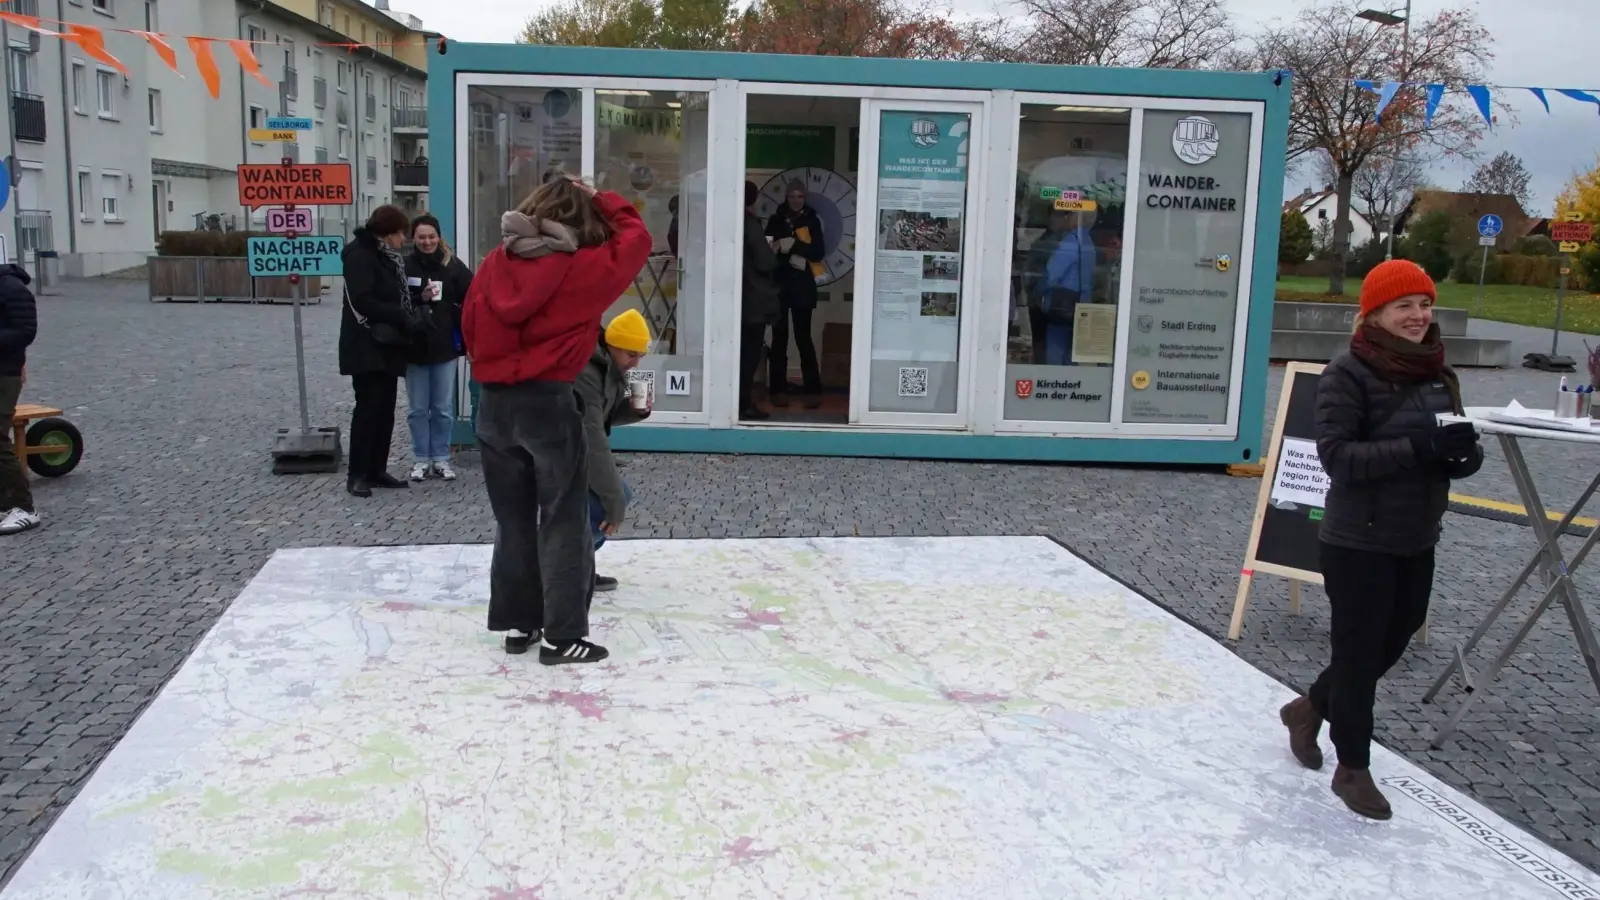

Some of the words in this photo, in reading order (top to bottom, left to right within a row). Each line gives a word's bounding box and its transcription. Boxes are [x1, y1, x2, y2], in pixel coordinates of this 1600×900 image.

[243, 168, 323, 183] WANDER
[884, 165, 961, 174] WANDERCONTAINER
[1148, 174, 1221, 191] WANDER-
[243, 185, 347, 200] CONTAINER
[1042, 189, 1060, 197] QUIZ
[1055, 201, 1083, 209] REGION
[1146, 194, 1236, 211] CONTAINER
[272, 213, 307, 228] DER
[253, 240, 339, 255] NACHBAR
[254, 257, 323, 272] SCHAFT
[1161, 320, 1185, 330] Stadt
[1187, 321, 1217, 333] Erding
[1157, 370, 1221, 380] Internationale
[670, 375, 685, 391] M
[1036, 379, 1082, 389] Kirchdorf
[1156, 382, 1226, 394] Bauausstellung
[1051, 391, 1068, 400] der
[1070, 391, 1102, 402] Amper
[1287, 449, 1305, 459] Was
[1306, 453, 1320, 461] ma
[1284, 460, 1324, 473] Nachbars
[1282, 471, 1309, 481] region
[1311, 474, 1324, 483] für
[1395, 779, 1600, 900] NACHBARSCHAFTSRE
